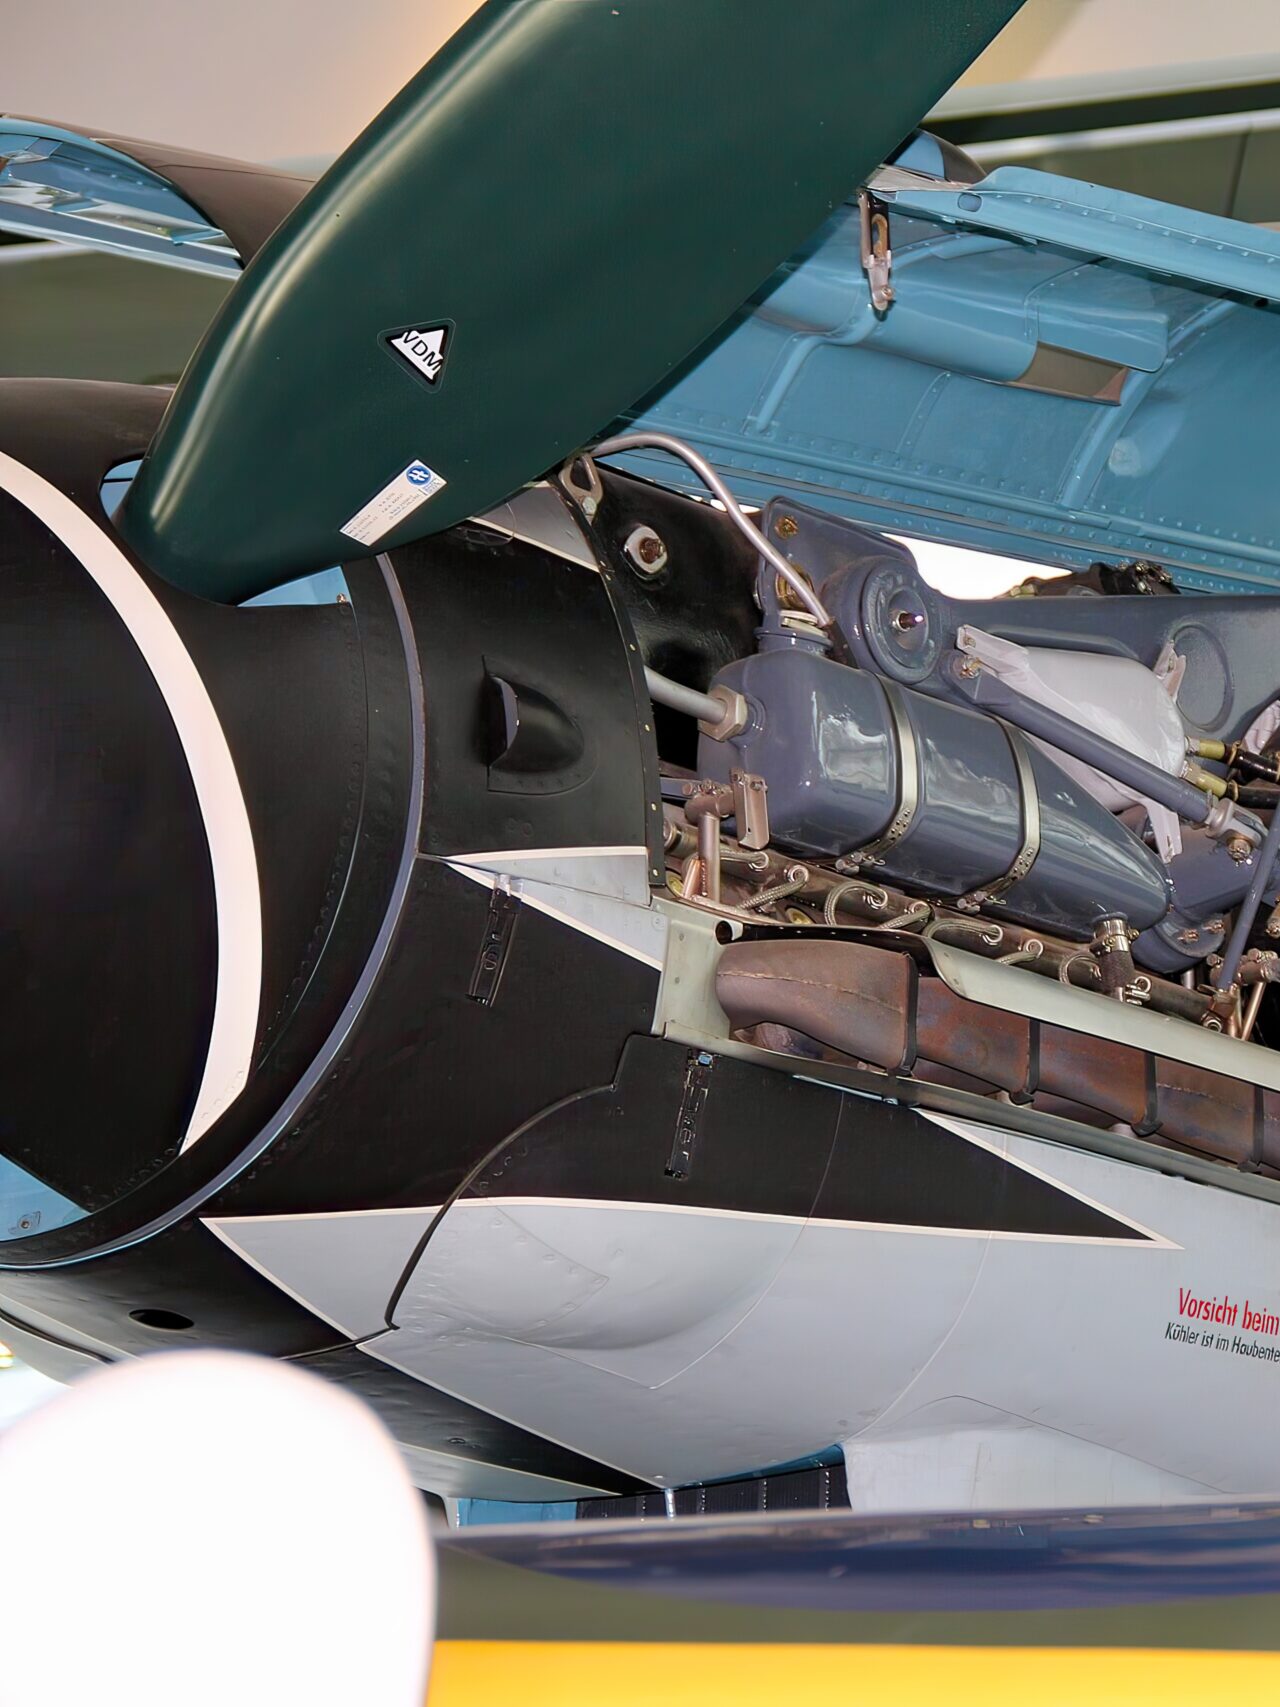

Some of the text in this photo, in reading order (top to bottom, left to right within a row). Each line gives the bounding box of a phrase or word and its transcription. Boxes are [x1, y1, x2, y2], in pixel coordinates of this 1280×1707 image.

[403, 329, 444, 371] VDM
[1179, 1287, 1239, 1327] Vorsicht
[1242, 1300, 1280, 1337] beim
[1165, 1322, 1200, 1345] Kühler
[1201, 1331, 1215, 1348] ist
[1215, 1333, 1230, 1352] im
